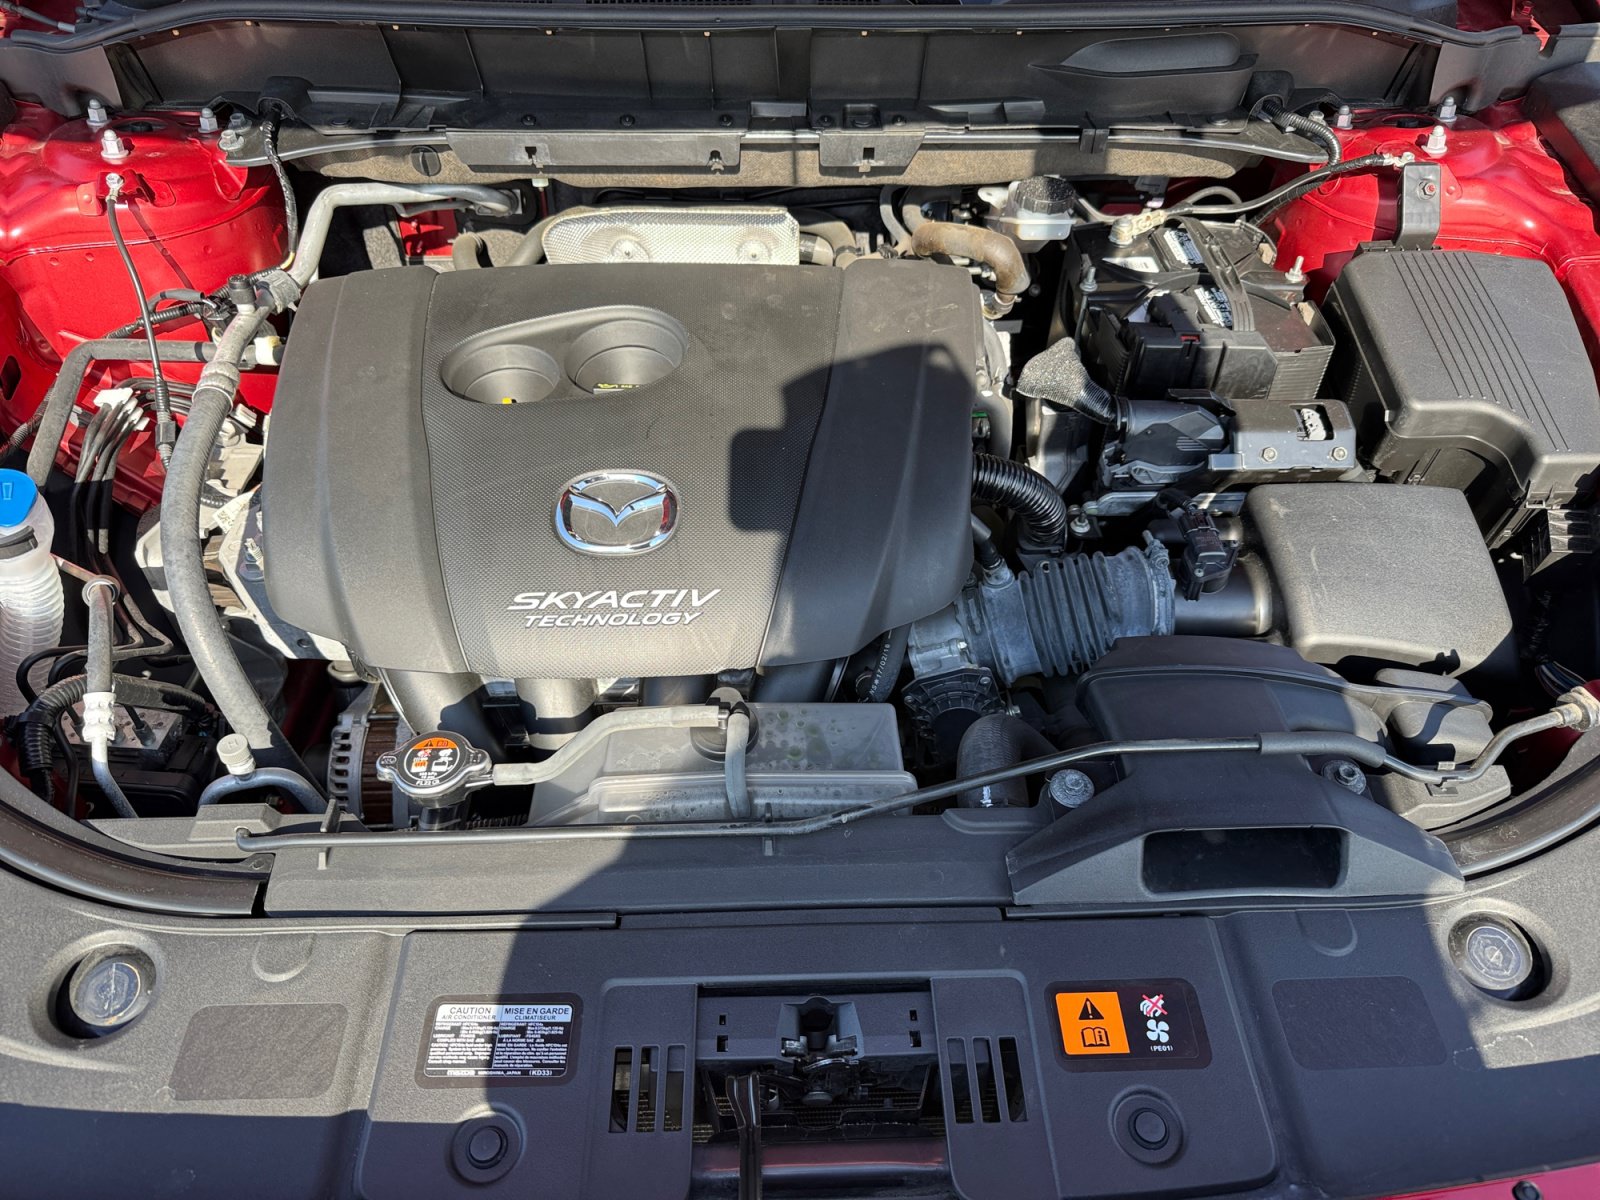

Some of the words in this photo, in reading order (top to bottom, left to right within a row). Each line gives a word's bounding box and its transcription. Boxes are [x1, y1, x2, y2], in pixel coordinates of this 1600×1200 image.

[507, 588, 722, 610] SKYACTIV
[525, 612, 703, 628] TECHNOLOGY
[450, 1007, 492, 1015] CAUTION
[504, 1007, 525, 1015] MISE
[526, 1007, 538, 1015] EN
[539, 1007, 570, 1015] GARDE
